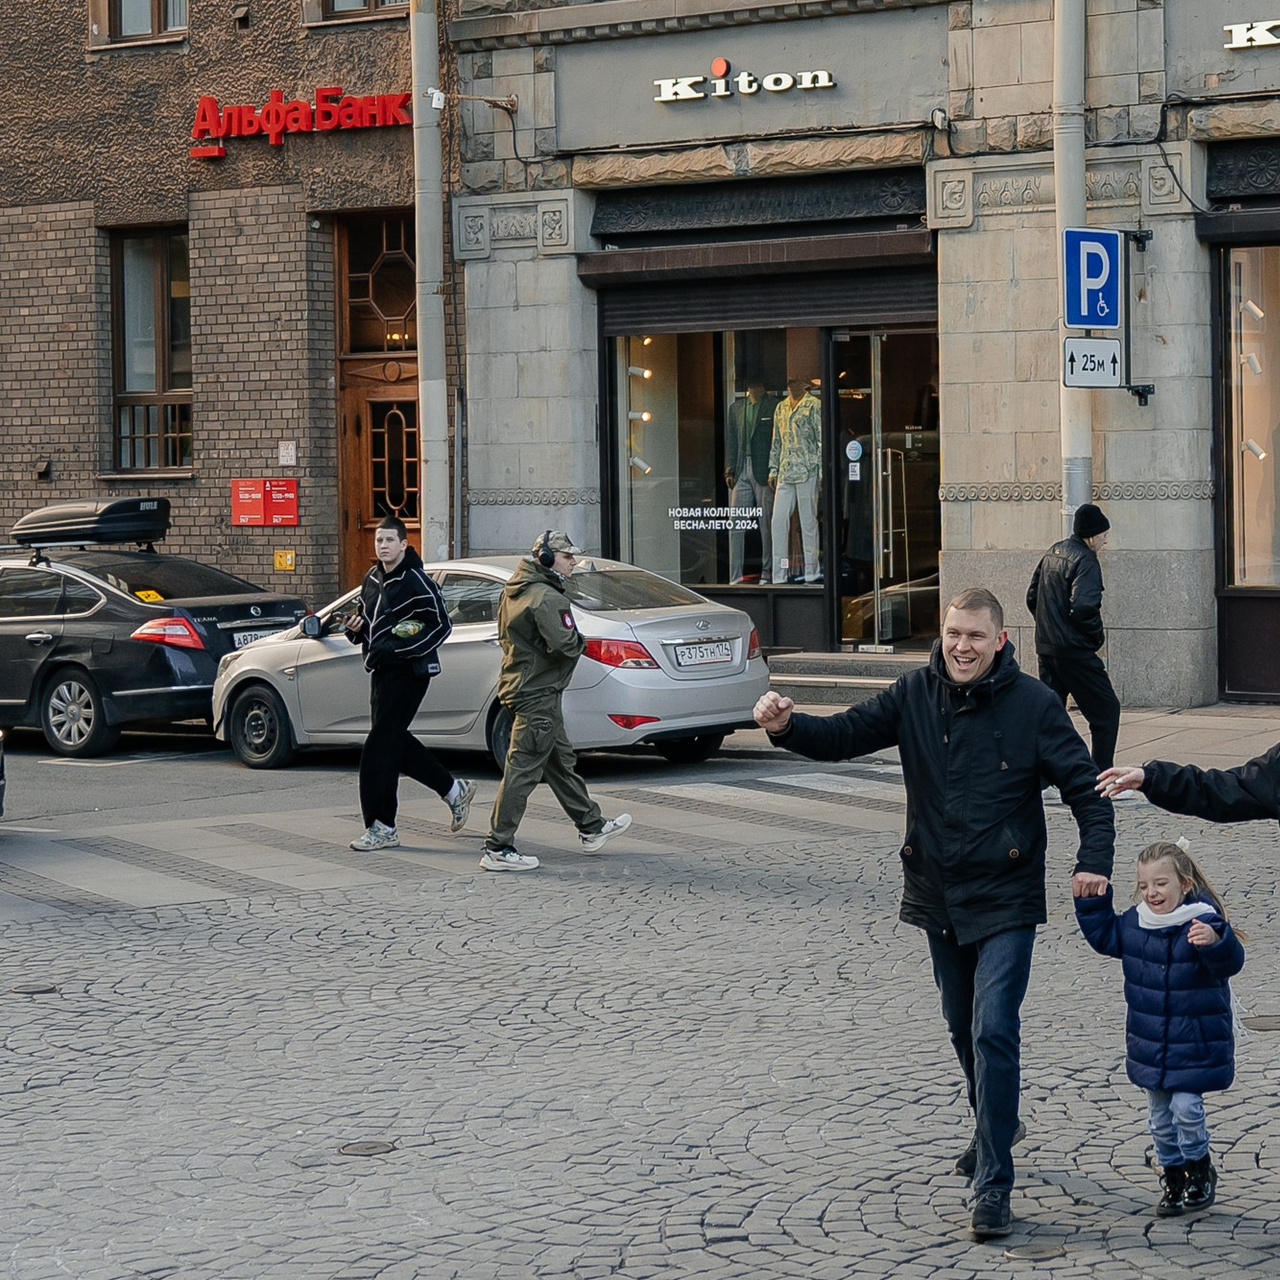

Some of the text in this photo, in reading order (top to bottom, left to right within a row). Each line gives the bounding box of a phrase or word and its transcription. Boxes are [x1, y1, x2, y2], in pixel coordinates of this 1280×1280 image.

[653, 57, 835, 102] Kiton
[1080, 241, 1110, 316] P
[668, 507, 763, 518] НОВАЯ КОЛЛЕКЦИЯ
[674, 520, 759, 530] ВЕСНА-ЛЕТО 2024
